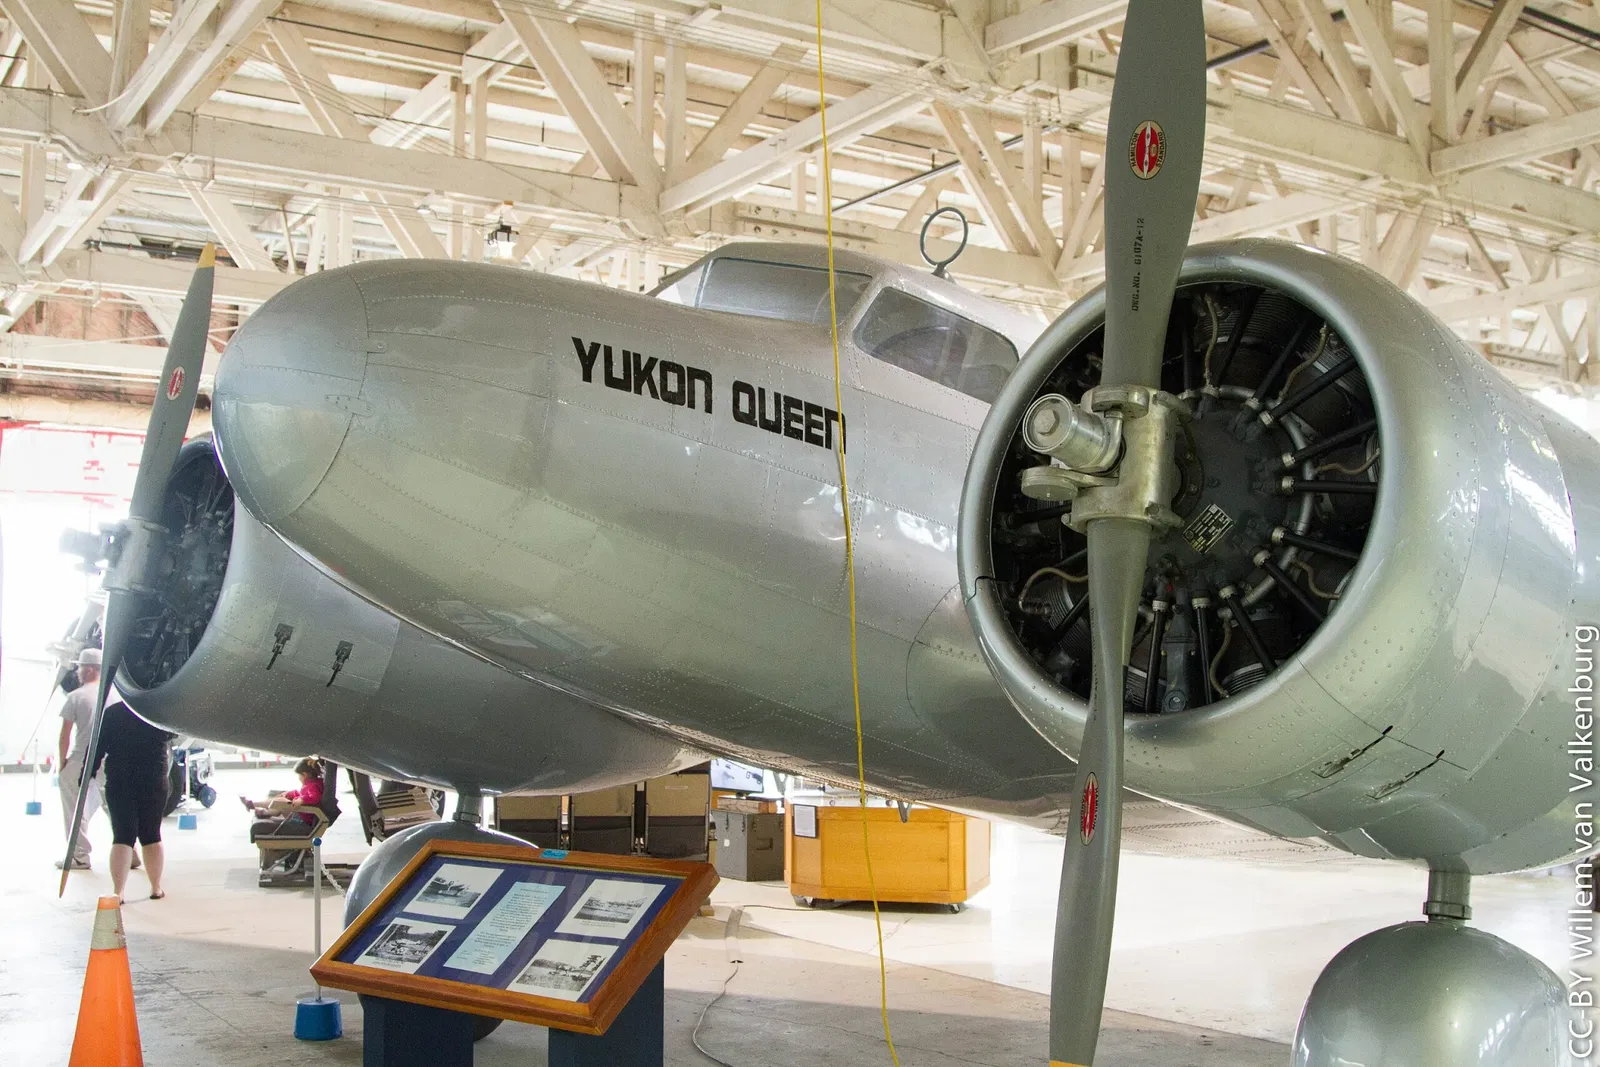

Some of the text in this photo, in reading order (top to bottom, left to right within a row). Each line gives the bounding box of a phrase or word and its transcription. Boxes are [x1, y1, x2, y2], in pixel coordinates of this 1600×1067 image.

[1130, 132, 1139, 167] HAMILTON
[1156, 131, 1165, 168] STANDARD
[571, 336, 847, 455] YUKON QUEEN
